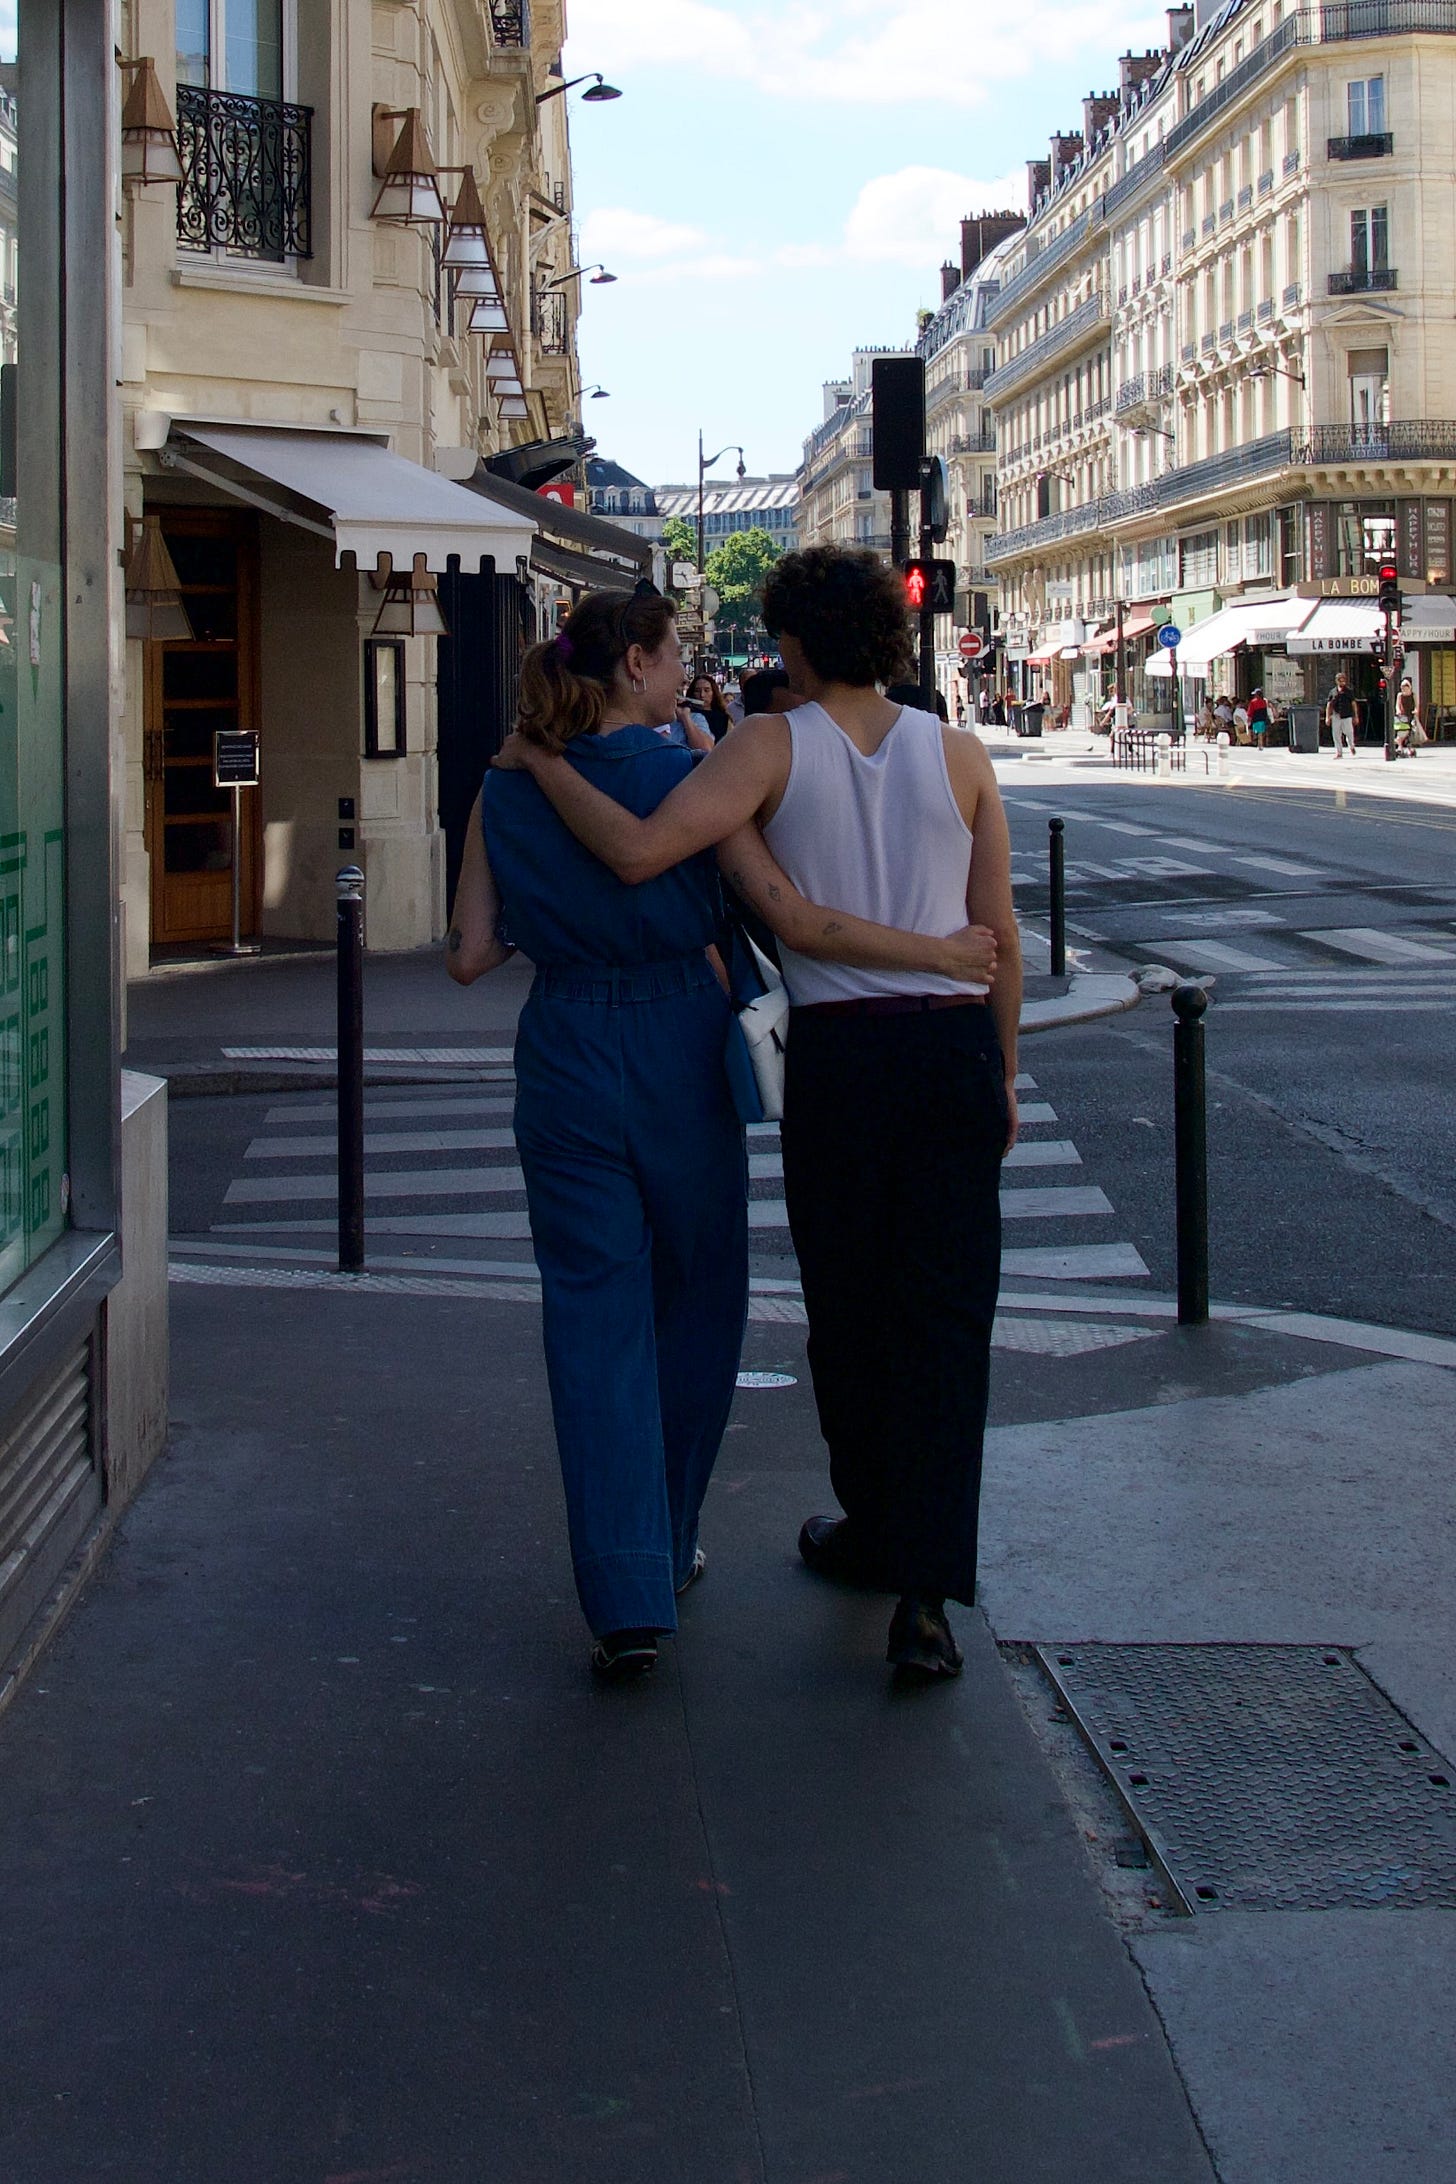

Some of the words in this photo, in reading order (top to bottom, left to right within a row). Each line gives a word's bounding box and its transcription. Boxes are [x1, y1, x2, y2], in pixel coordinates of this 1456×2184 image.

[1321, 580, 1340, 595] LA
[1350, 580, 1380, 594] BOM
[1401, 628, 1451, 639] APPY/HOUR
[1312, 640, 1324, 650] LA
[1328, 639, 1363, 649] BOMBE
